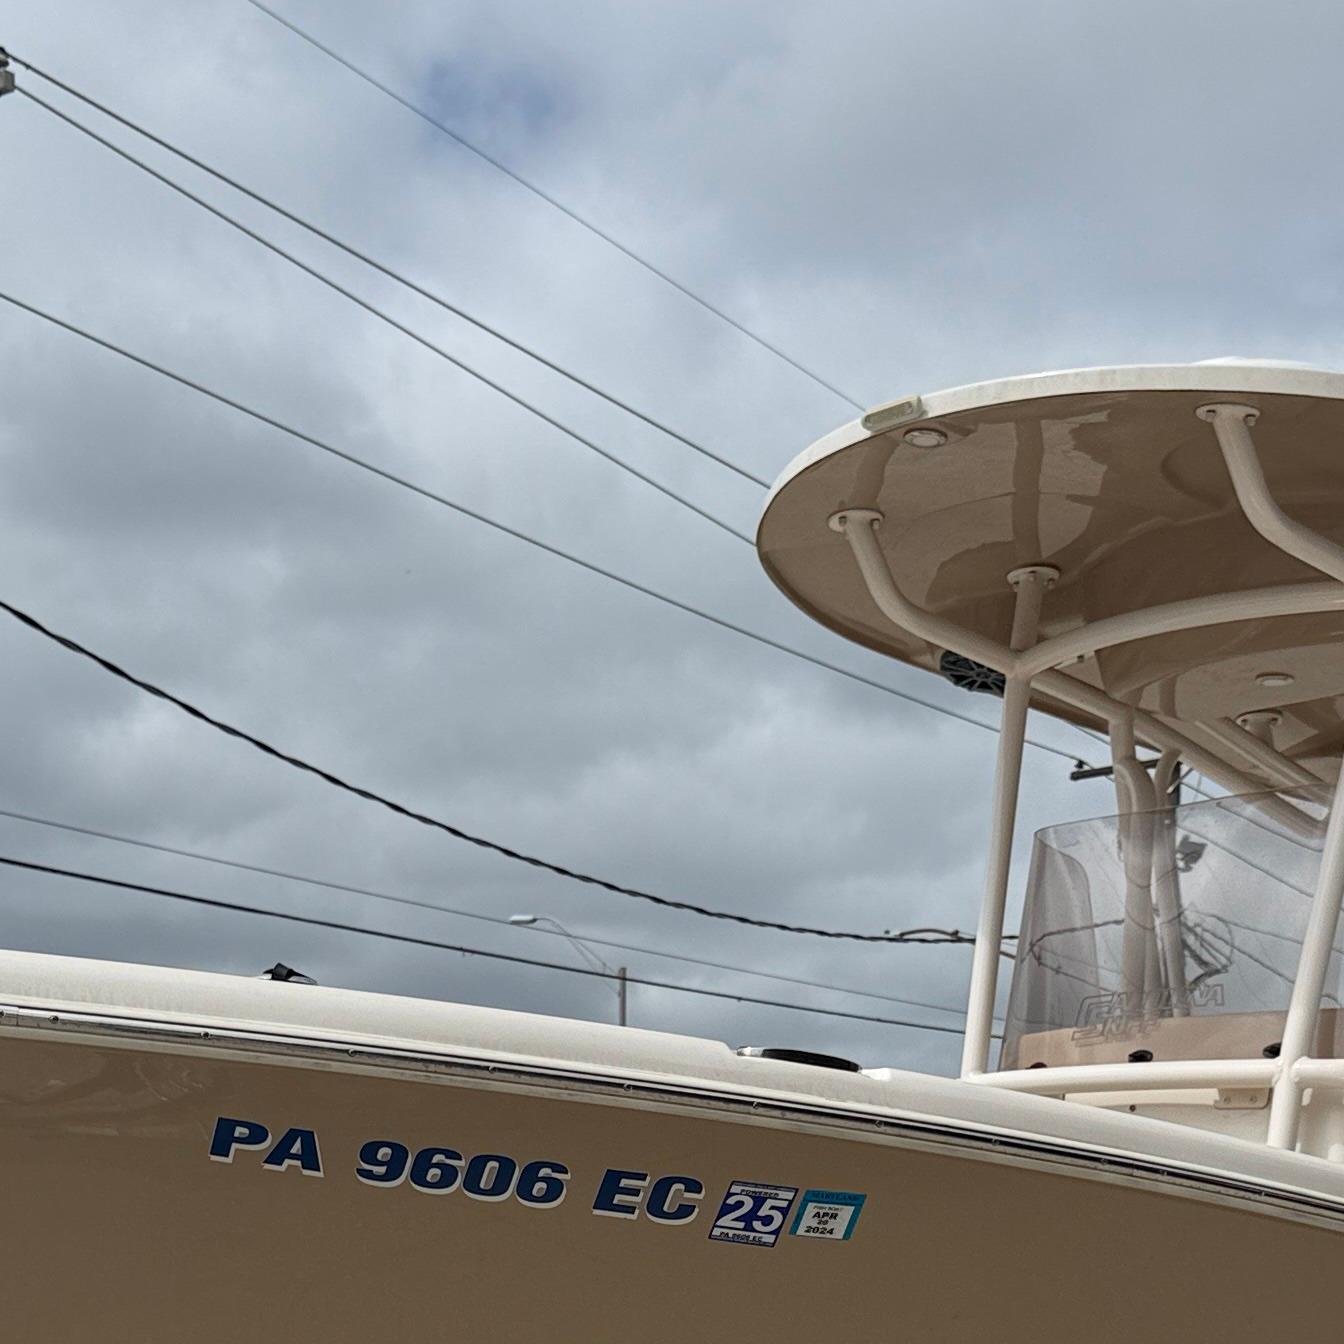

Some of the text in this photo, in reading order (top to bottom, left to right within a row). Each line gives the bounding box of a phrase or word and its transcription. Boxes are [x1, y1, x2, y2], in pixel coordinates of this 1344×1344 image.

[209, 1116, 706, 1225] PA 9606 EC
[715, 1194, 789, 1233] 25
[812, 1211, 839, 1220] APR
[804, 1225, 835, 1235] 2024
